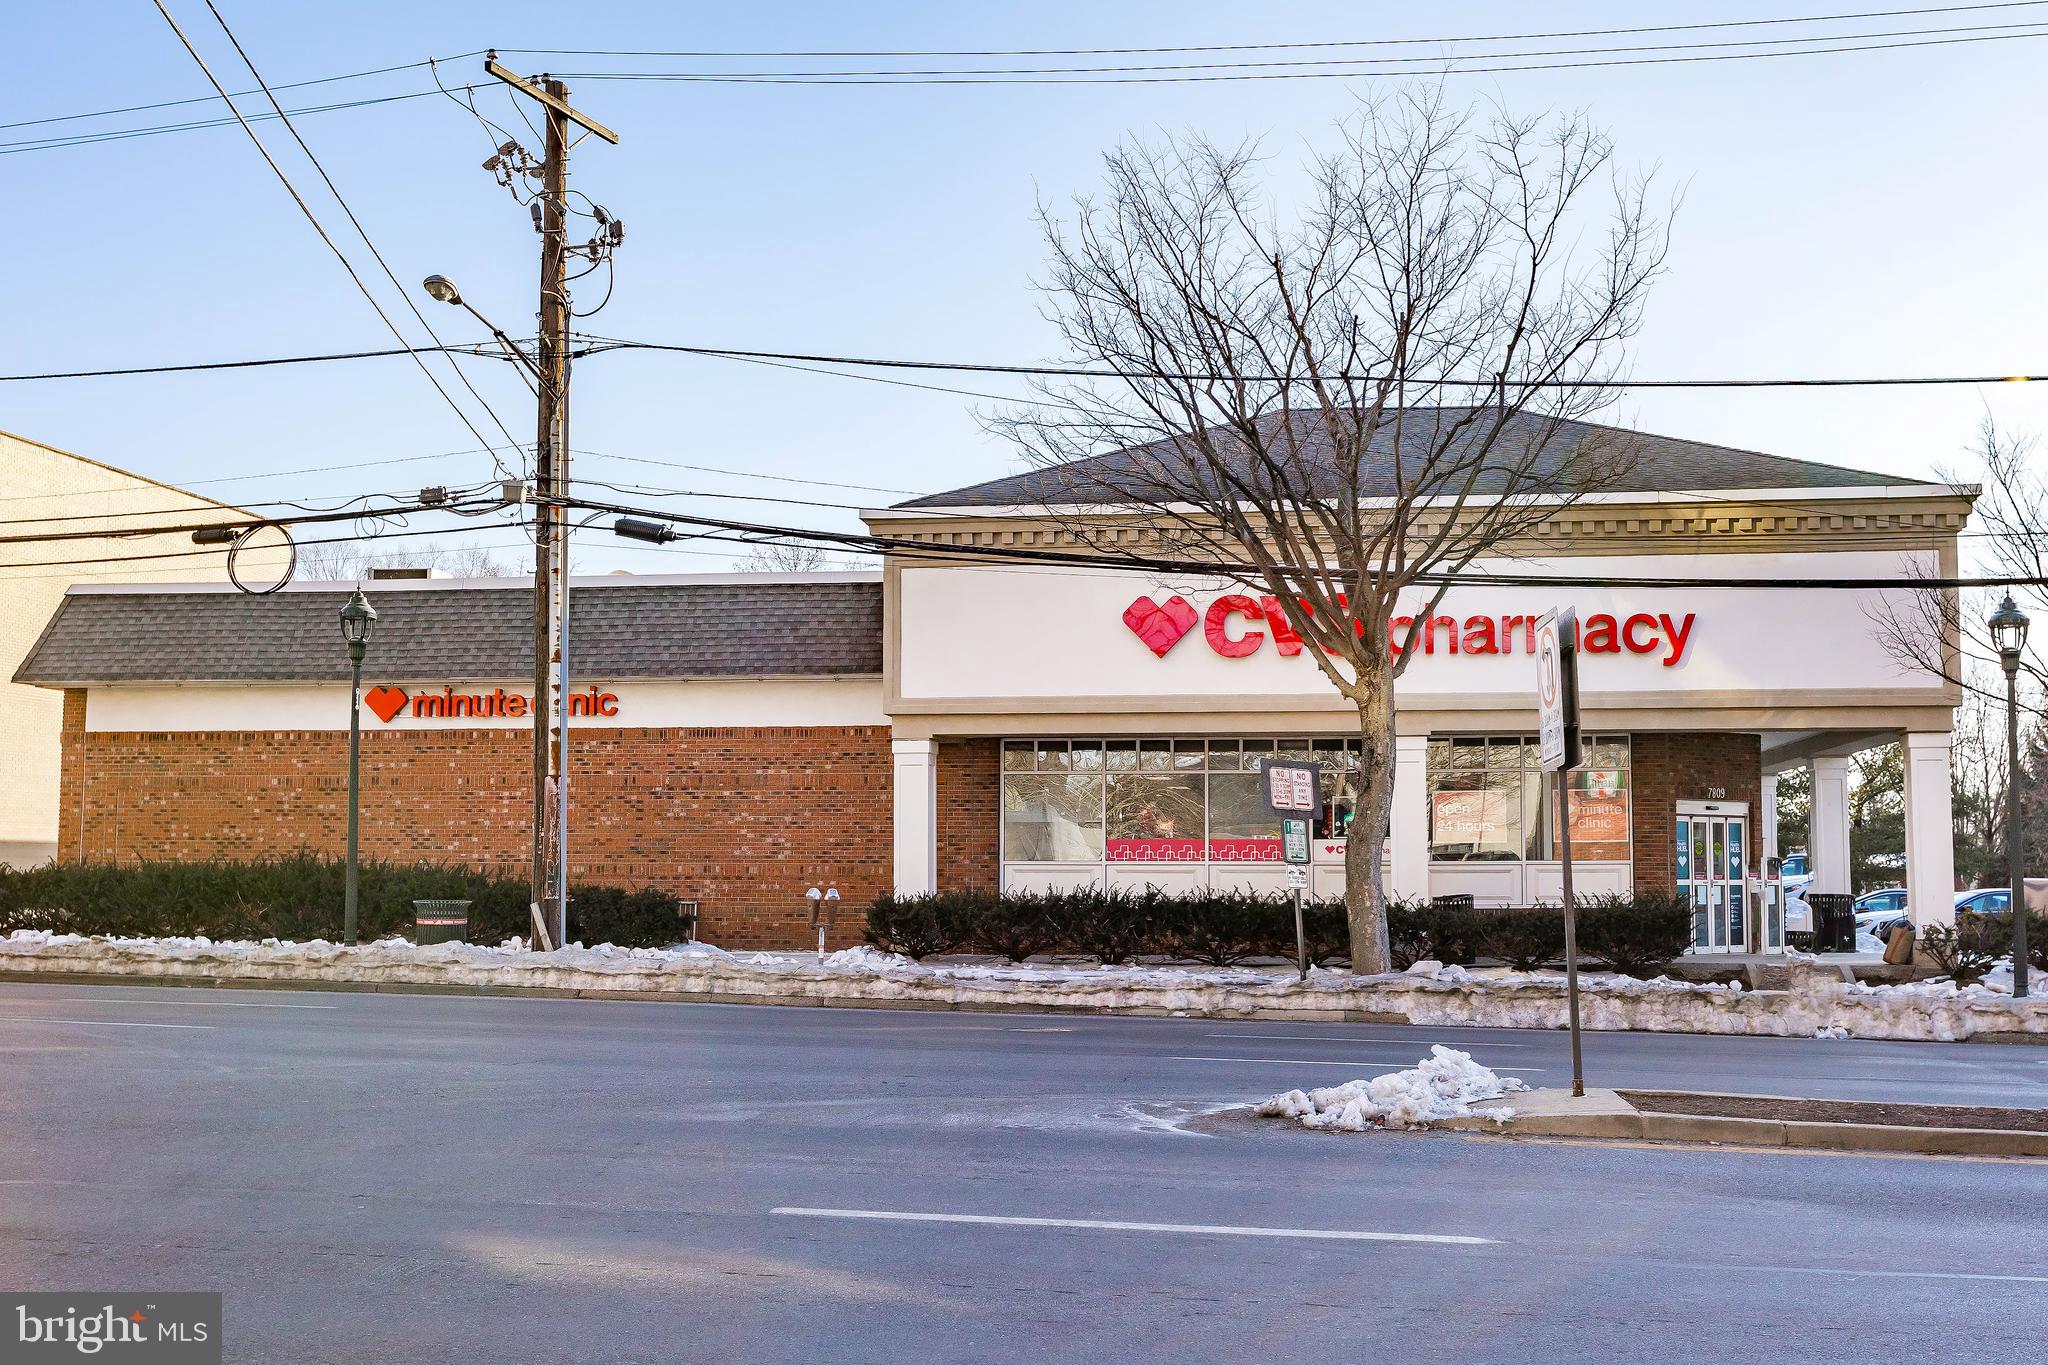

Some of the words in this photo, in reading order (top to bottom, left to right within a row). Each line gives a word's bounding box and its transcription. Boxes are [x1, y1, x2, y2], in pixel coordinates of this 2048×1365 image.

[412, 685, 526, 717] minute
[1276, 769, 1284, 777] NO
[1296, 772, 1306, 780] NO
[1708, 787, 1725, 798] 7809
[1437, 804, 1470, 816] open
[1579, 803, 1623, 815] minute
[1437, 820, 1454, 832] 24
[1456, 819, 1495, 832] hours
[1577, 816, 1612, 828] clinic
